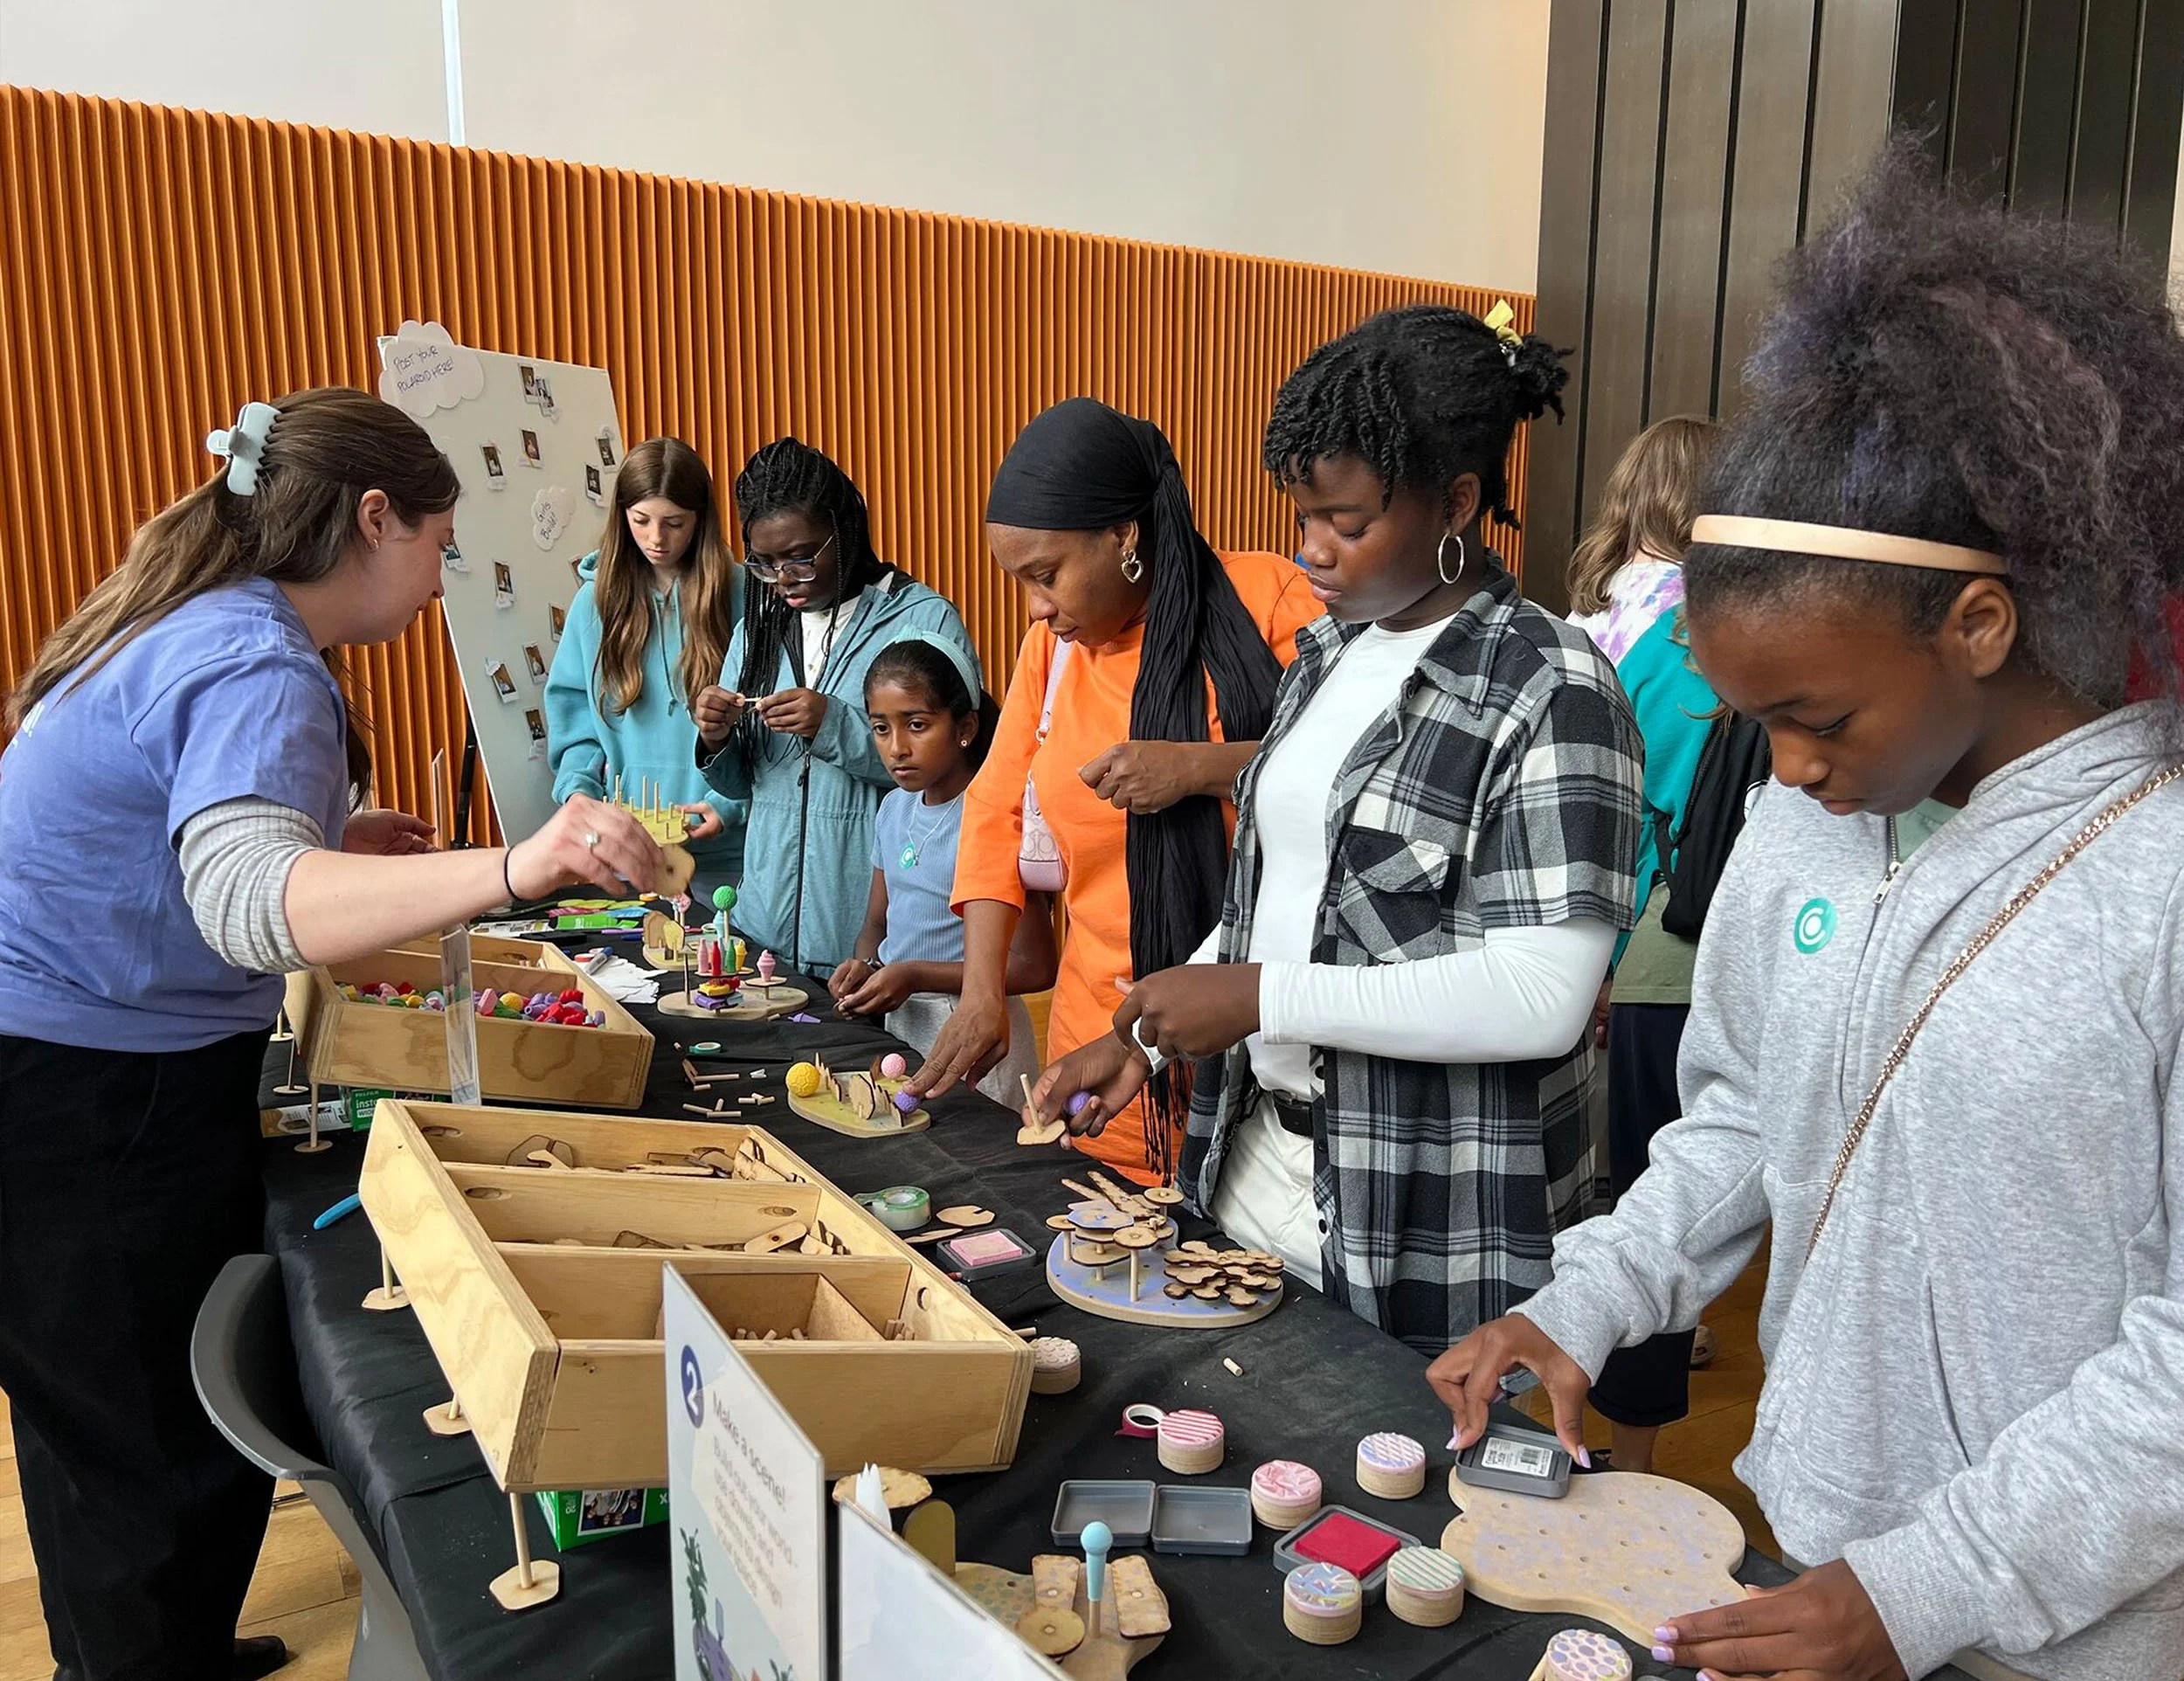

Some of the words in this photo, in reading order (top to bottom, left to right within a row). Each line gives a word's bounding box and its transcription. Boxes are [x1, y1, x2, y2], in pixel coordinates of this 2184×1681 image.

[393, 353, 413, 375] POST
[416, 345, 438, 363] YOUR
[397, 370, 432, 394] POLAROID
[536, 502, 551, 522] Girls
[687, 1360, 699, 1416] 2
[713, 1390, 739, 1445] Make
[741, 1437, 748, 1457] a
[749, 1448, 786, 1513] scene!
